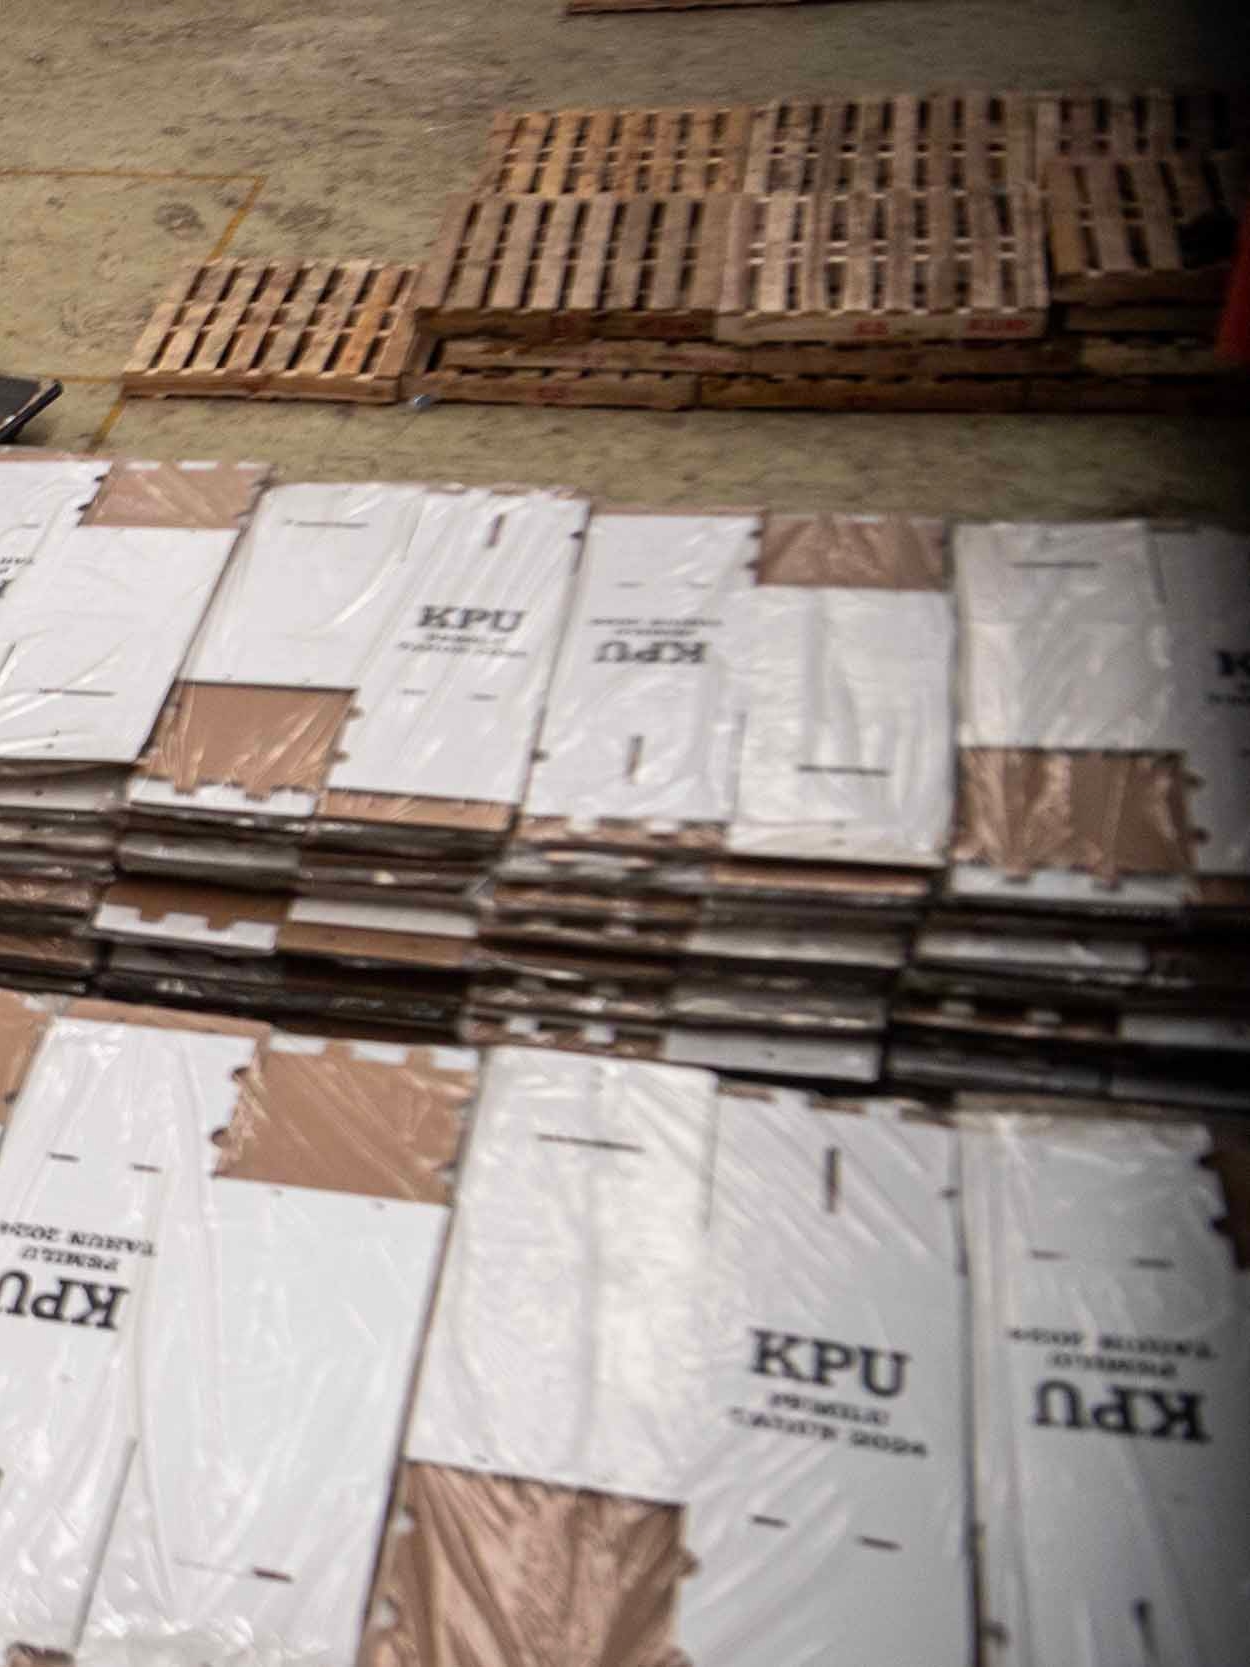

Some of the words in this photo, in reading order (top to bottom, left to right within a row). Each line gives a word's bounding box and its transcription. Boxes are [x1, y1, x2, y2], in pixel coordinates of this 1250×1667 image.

[417, 606, 526, 632] KPU
[592, 641, 710, 663] KPU
[67, 1229, 156, 1257] TAHUN
[20, 1244, 119, 1271] PEMILU
[748, 1327, 908, 1398] KPU
[1032, 1379, 1212, 1444] KPU
